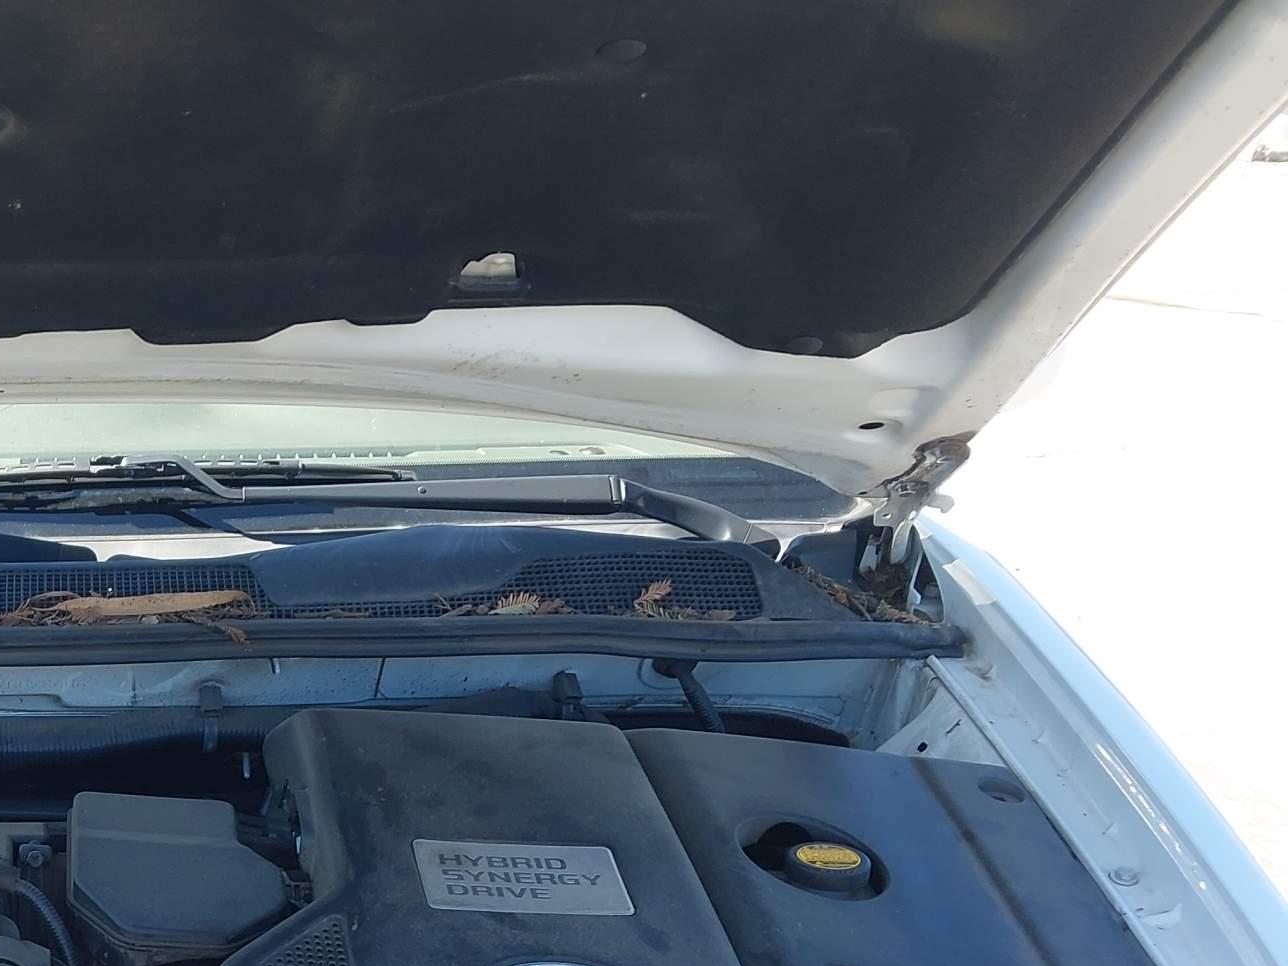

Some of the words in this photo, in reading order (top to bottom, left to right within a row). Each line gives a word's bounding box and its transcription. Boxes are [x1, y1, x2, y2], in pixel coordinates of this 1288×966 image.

[438, 853, 567, 870] HYBRID
[442, 868, 601, 886] SYNERGY
[446, 884, 552, 900] DRIVE
